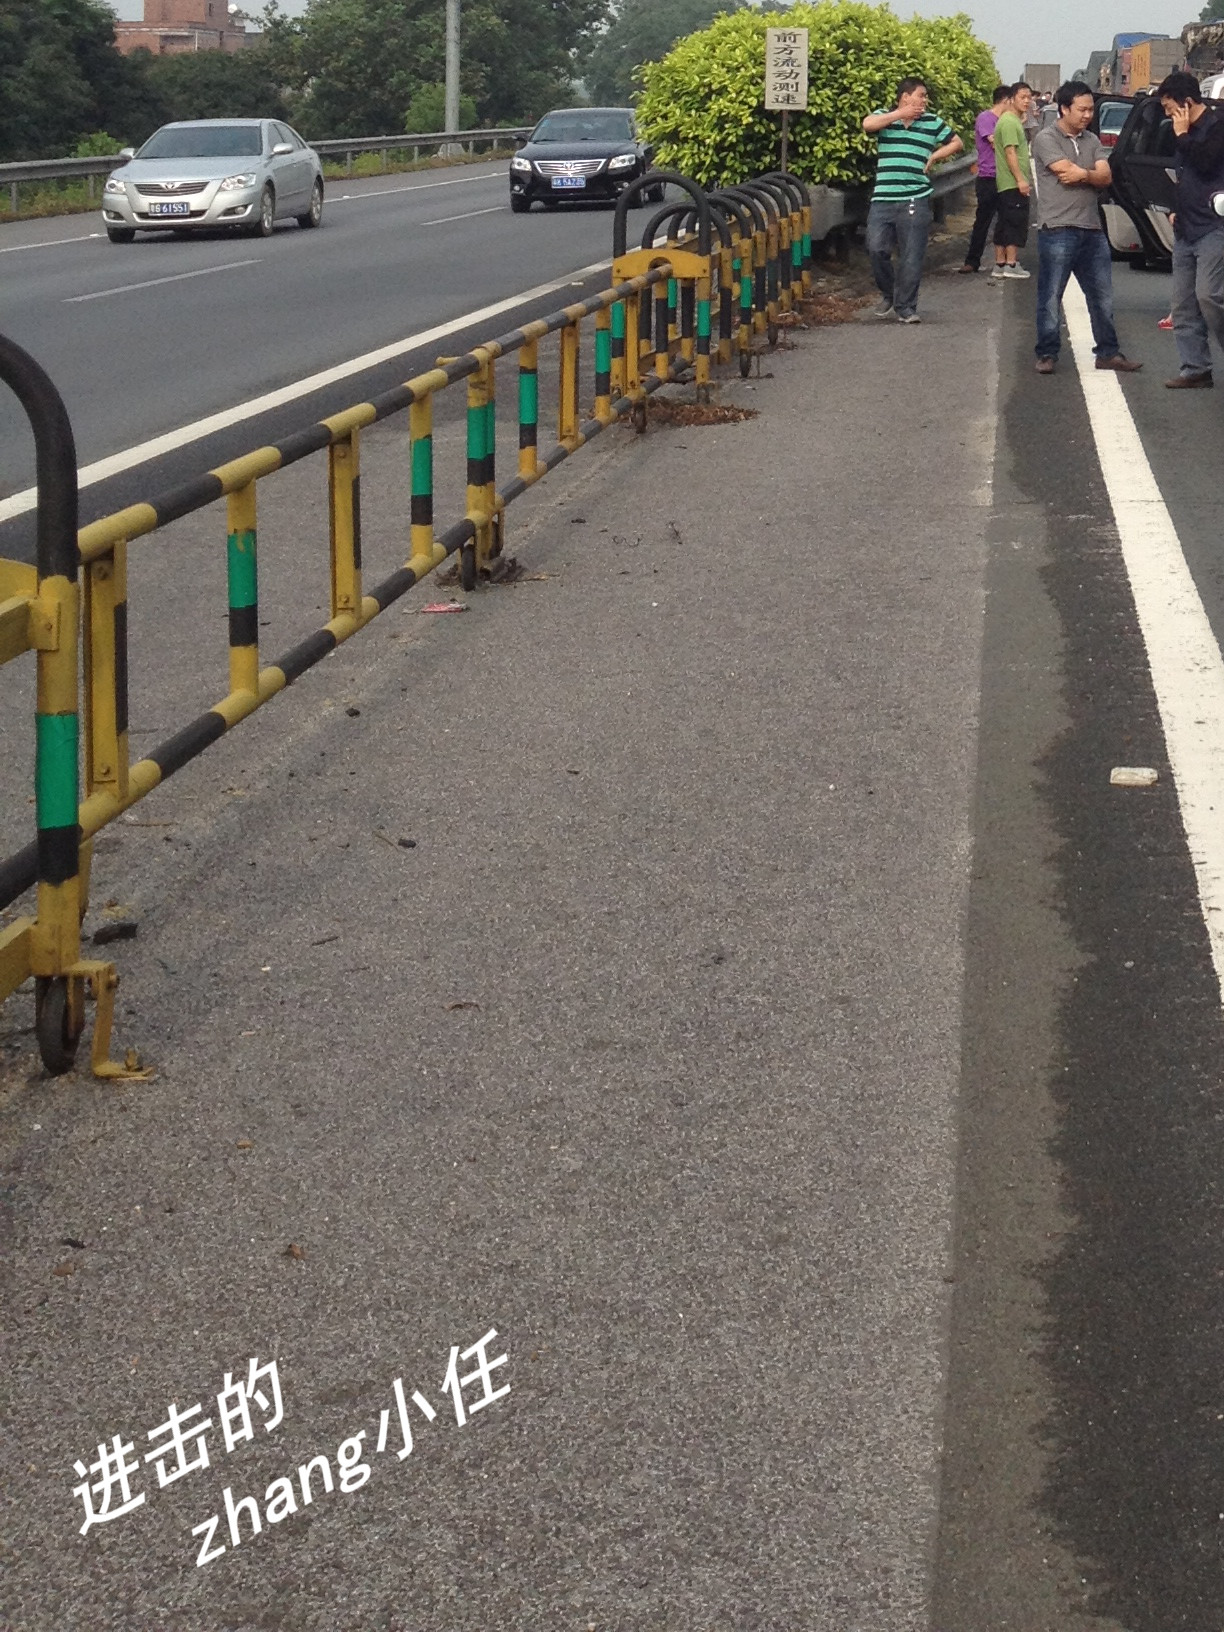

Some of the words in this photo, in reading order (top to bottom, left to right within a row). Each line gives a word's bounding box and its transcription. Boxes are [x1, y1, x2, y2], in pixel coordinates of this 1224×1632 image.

[771, 31, 803, 105] 前方流动测速
